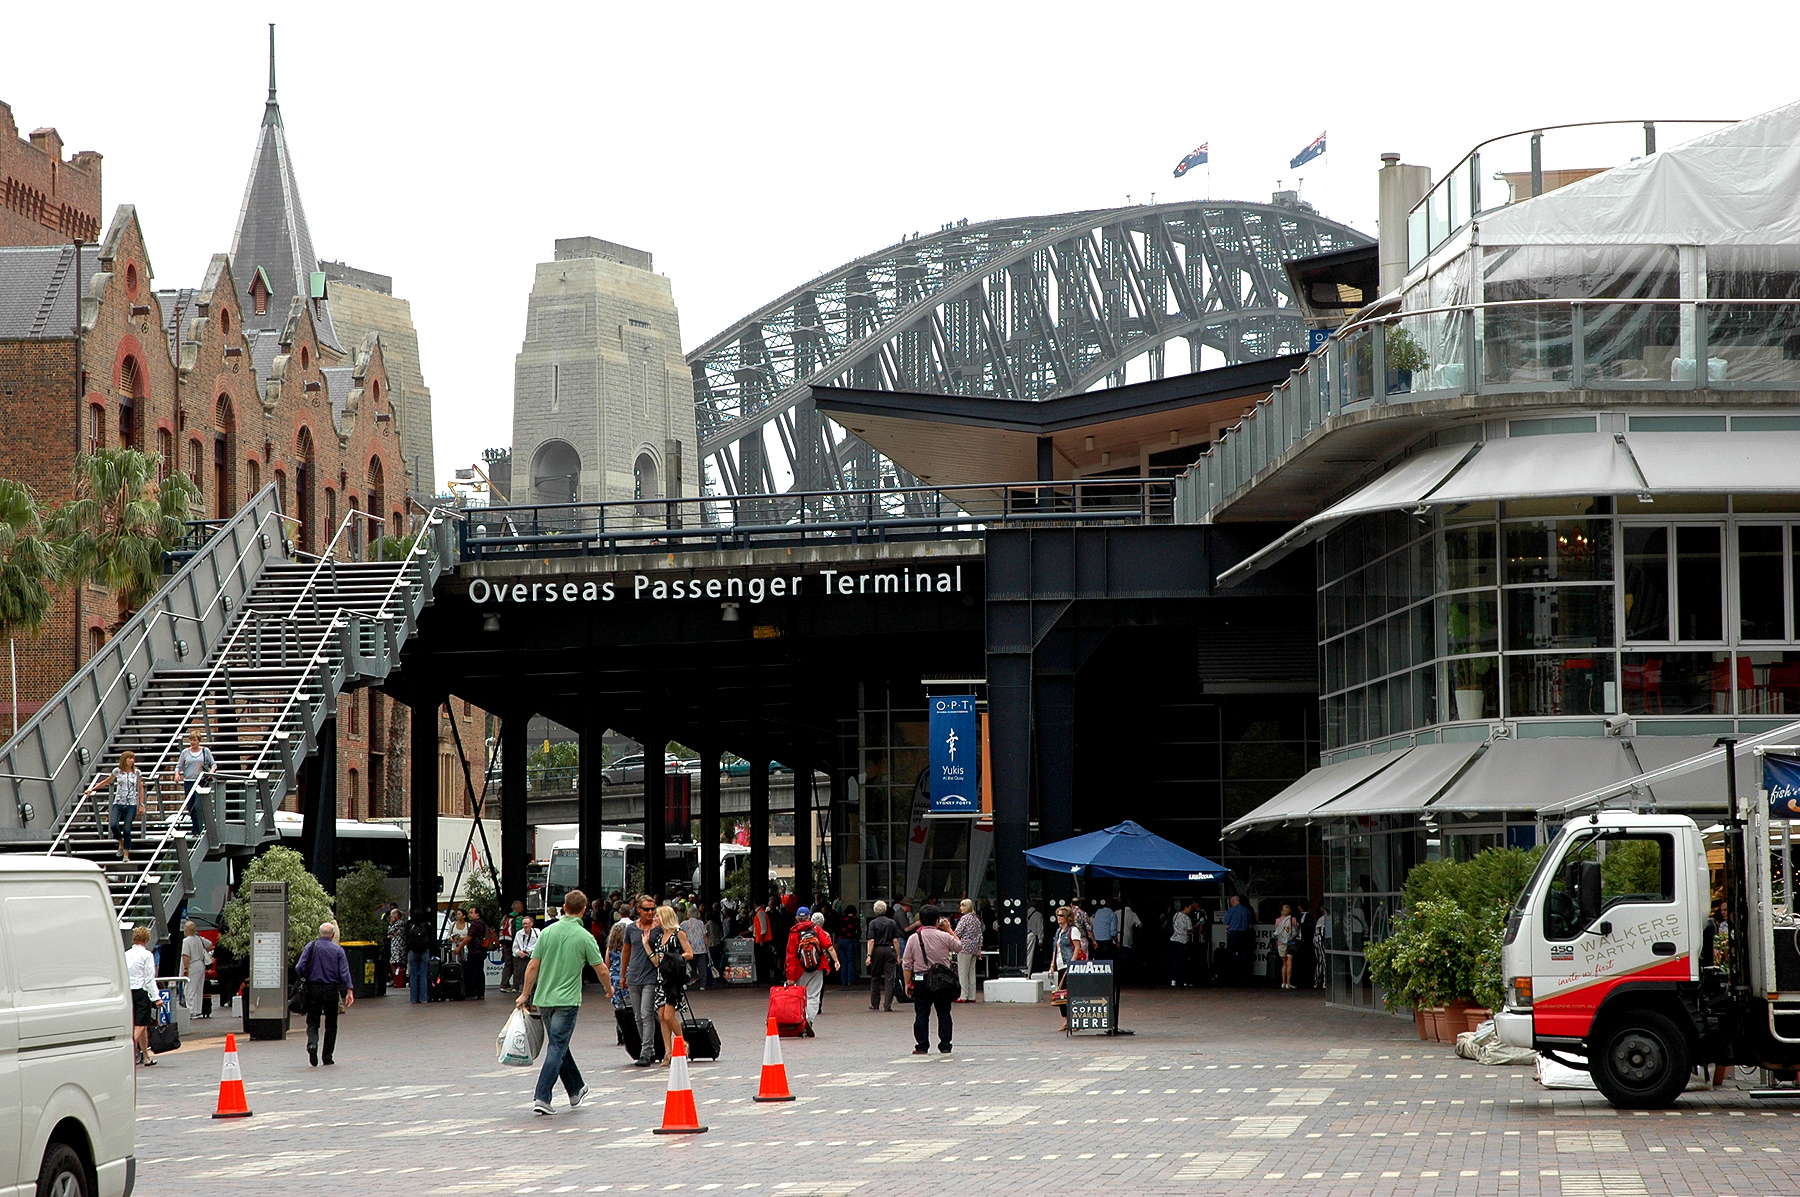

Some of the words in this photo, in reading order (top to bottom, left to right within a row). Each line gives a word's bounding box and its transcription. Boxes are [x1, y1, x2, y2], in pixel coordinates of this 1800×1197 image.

[468, 577, 615, 604] Overseas
[634, 573, 803, 604] Passenger
[820, 565, 962, 595] Terminal
[942, 766, 964, 775] Yukis
[1770, 784, 1792, 805] fish
[1580, 913, 1679, 953] WALKERS
[1550, 945, 1574, 953] 450
[1585, 940, 1637, 964] PARTY
[1642, 926, 1682, 945] HIRE
[1068, 961, 1112, 974] LAVAZZA
[1594, 959, 1616, 979] first
[1072, 1018, 1108, 1028] HERE
